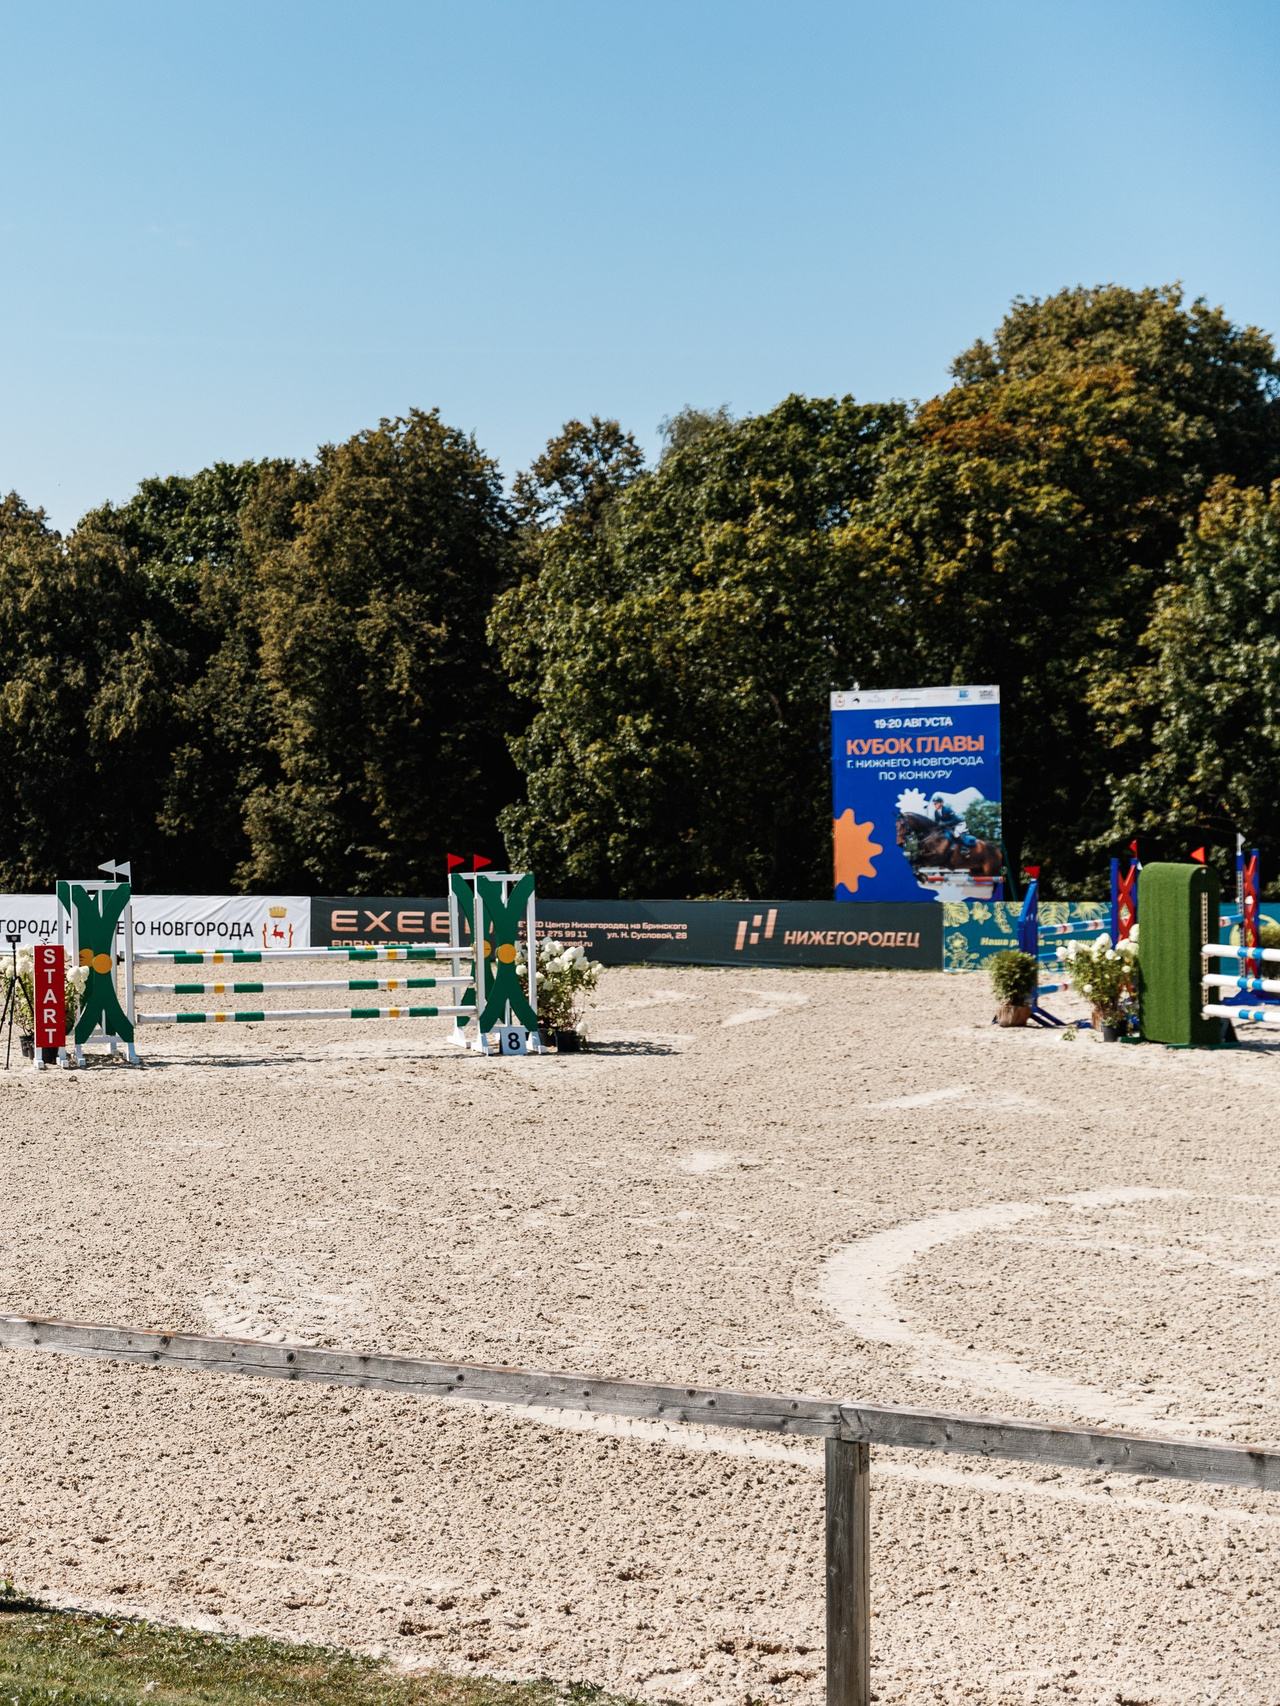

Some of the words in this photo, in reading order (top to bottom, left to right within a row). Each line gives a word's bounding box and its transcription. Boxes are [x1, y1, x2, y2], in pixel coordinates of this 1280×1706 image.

[874, 718, 902, 729] 19-20
[903, 716, 953, 728] АВГУСТА
[846, 737, 914, 755] КУБОК
[916, 734, 984, 753] ГЛАВЫ
[846, 760, 855, 769] Г.
[856, 758, 911, 768] НИЖНЕГО
[913, 756, 984, 767] НОВГОРОДА
[878, 771, 896, 781] ПО
[899, 769, 952, 780] КОНКУРУ
[150, 921, 254, 940] НОВГОРОДА
[545, 921, 570, 929] Центр
[571, 922, 629, 930] Нижегородец
[783, 931, 920, 948] НИЖЕГОРОДЕЦ
[980, 937, 1008, 946] Наша
[43, 949, 57, 1044] START
[508, 1032, 520, 1050] 8
